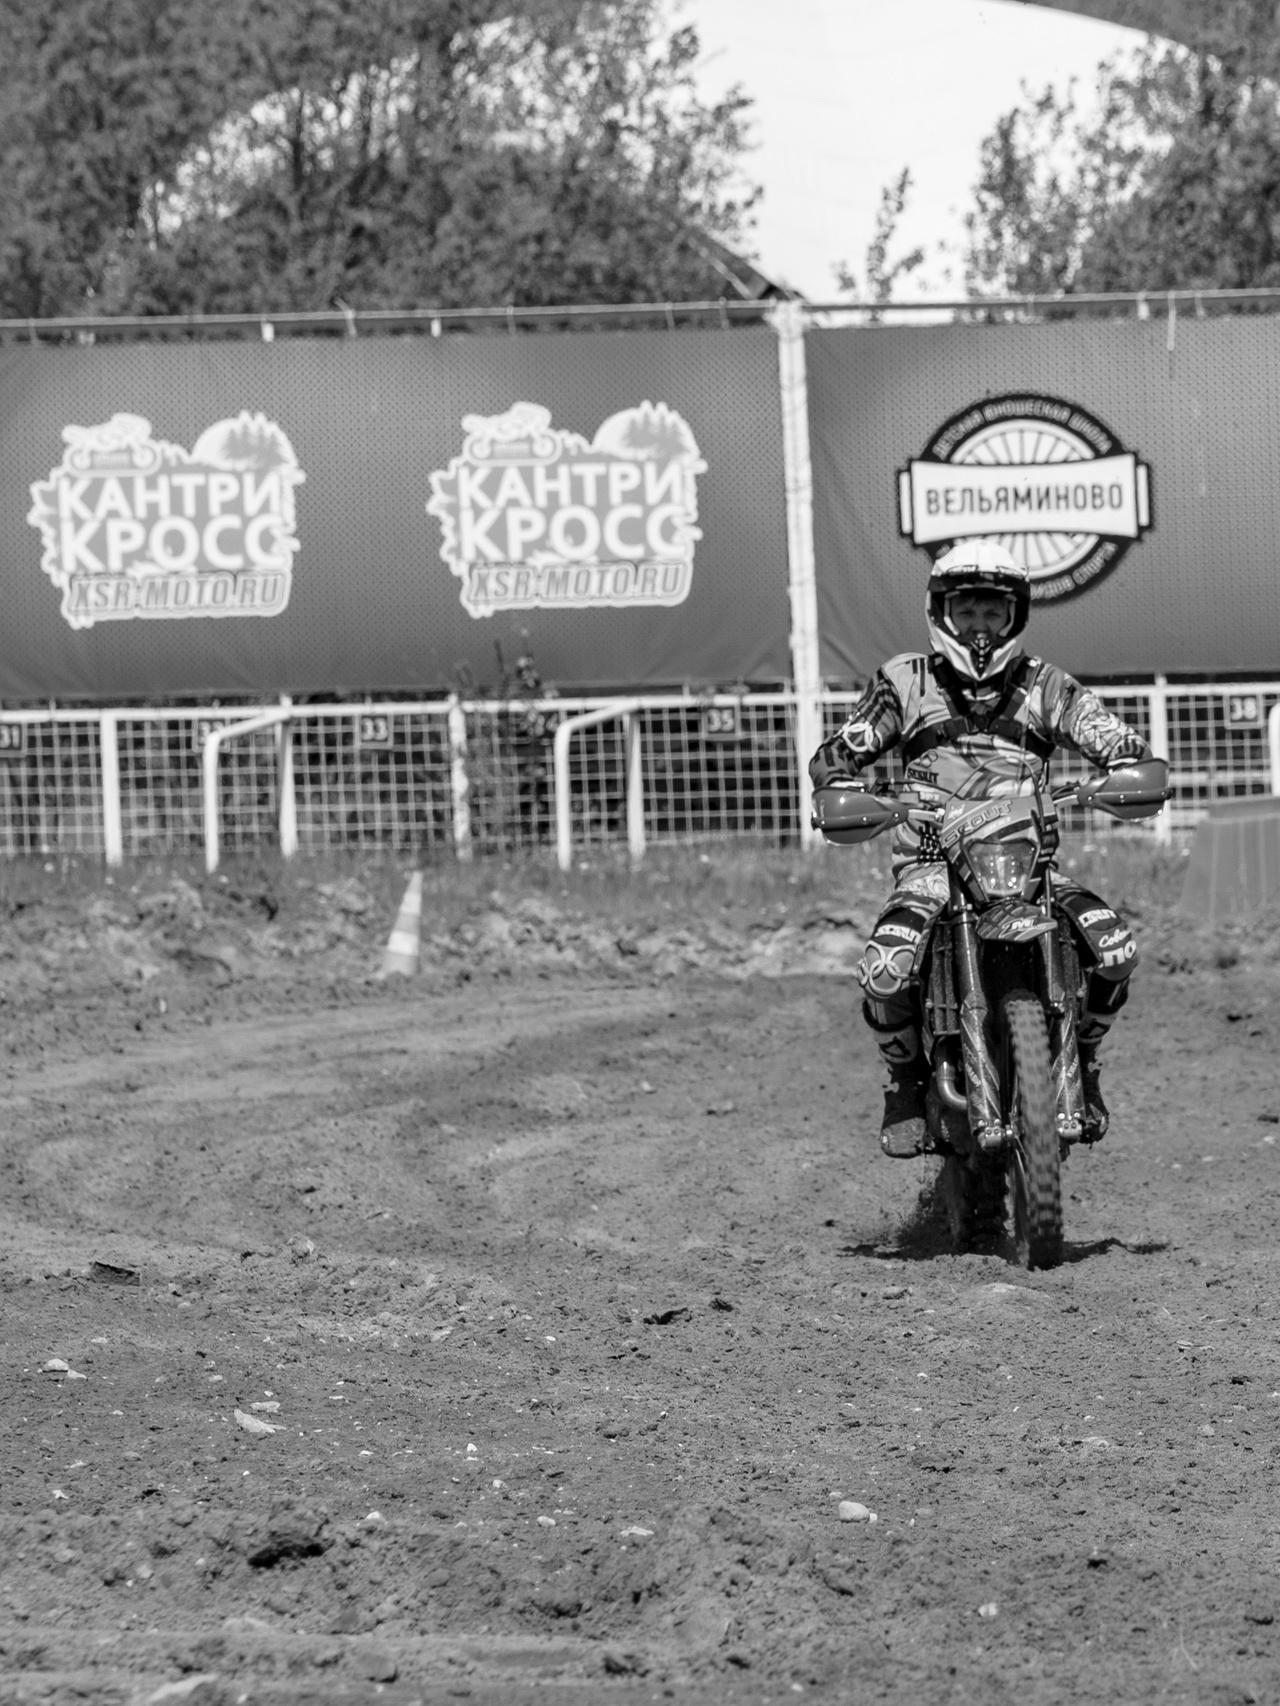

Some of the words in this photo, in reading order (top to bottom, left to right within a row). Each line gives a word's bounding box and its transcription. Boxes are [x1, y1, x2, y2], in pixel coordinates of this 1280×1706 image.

[58, 471, 281, 520] КАНТРИ
[458, 461, 681, 509] КАНТРИ
[926, 484, 1123, 516] ВЕЛЬЯМИНОВО
[61, 514, 286, 573] КРОСС
[460, 503, 687, 562] КРОСС
[707, 708, 734, 732] 35
[1230, 697, 1257, 720] 38
[361, 718, 388, 741] 33
